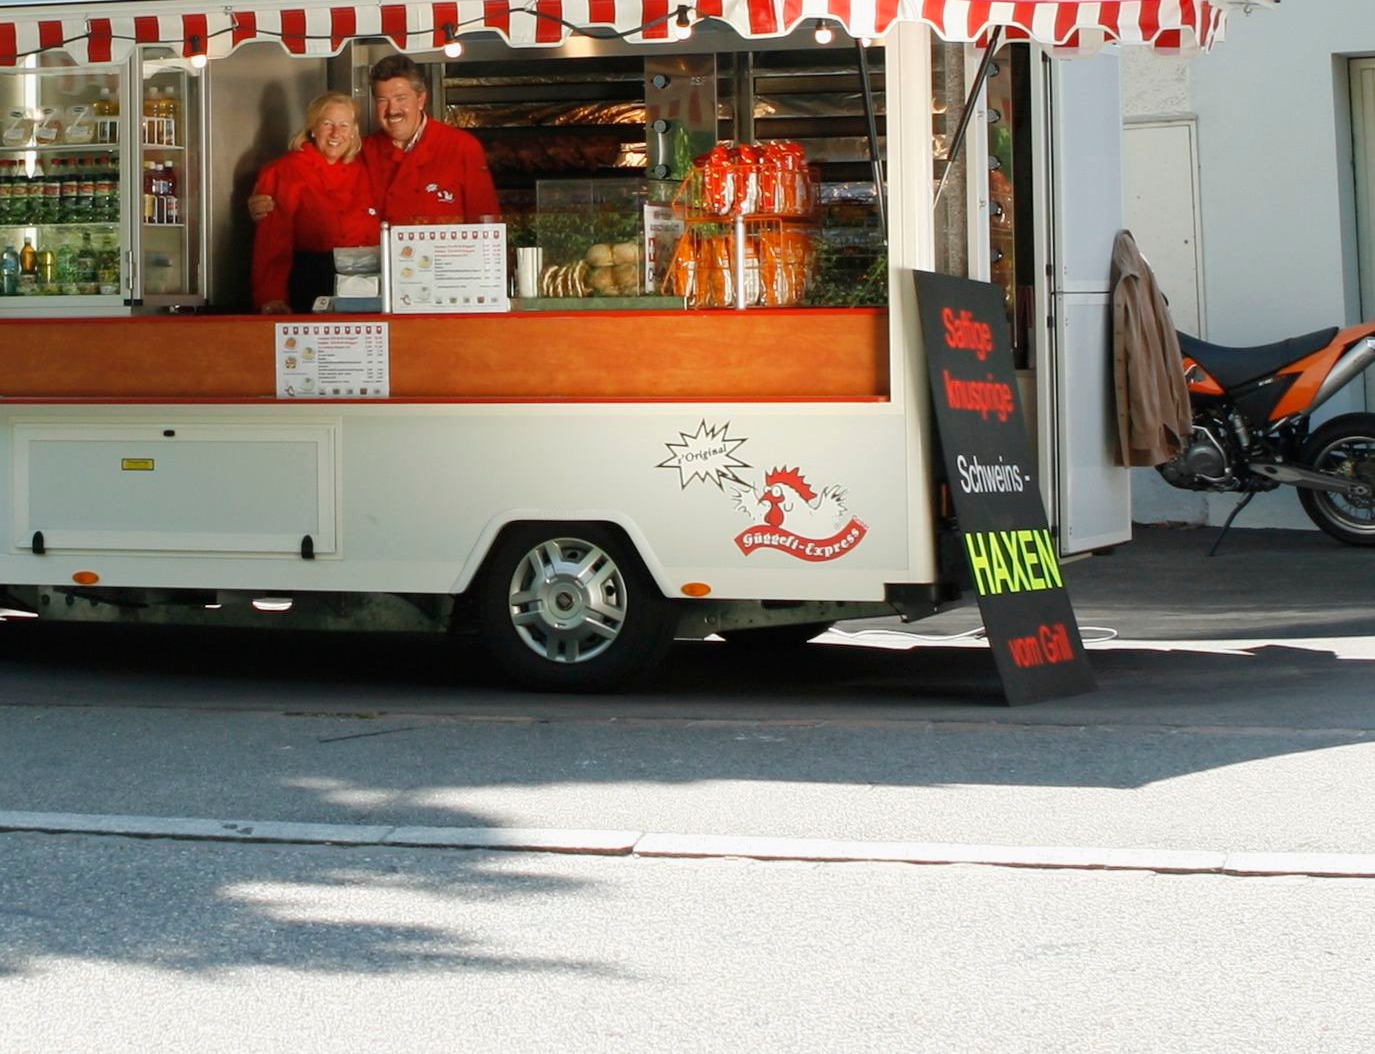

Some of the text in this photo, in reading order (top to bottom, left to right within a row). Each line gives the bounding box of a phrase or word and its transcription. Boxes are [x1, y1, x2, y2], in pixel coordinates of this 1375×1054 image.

[677, 443, 727, 465] s'Original
[742, 528, 860, 558] Güggeli-Express
[964, 528, 1064, 596] HAXEN
[1008, 622, 1075, 668] vom Grill
